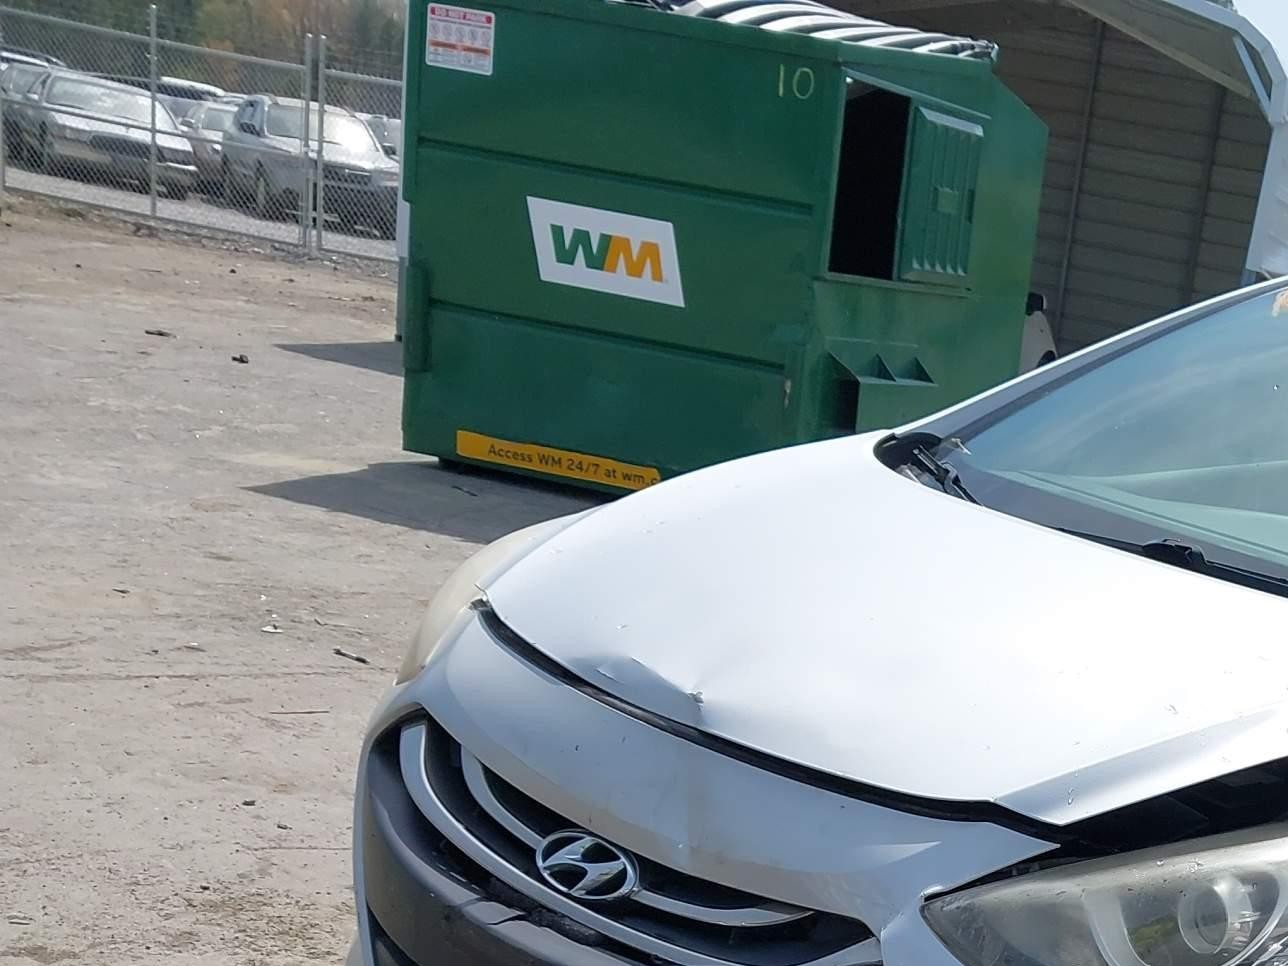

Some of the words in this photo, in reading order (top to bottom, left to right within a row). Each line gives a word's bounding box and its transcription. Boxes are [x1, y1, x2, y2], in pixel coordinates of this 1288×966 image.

[779, 63, 815, 99] 10
[549, 223, 664, 283] WM
[487, 444, 533, 464] Access
[537, 453, 563, 469] WM
[567, 458, 600, 476] 24/7
[604, 466, 617, 479] at
